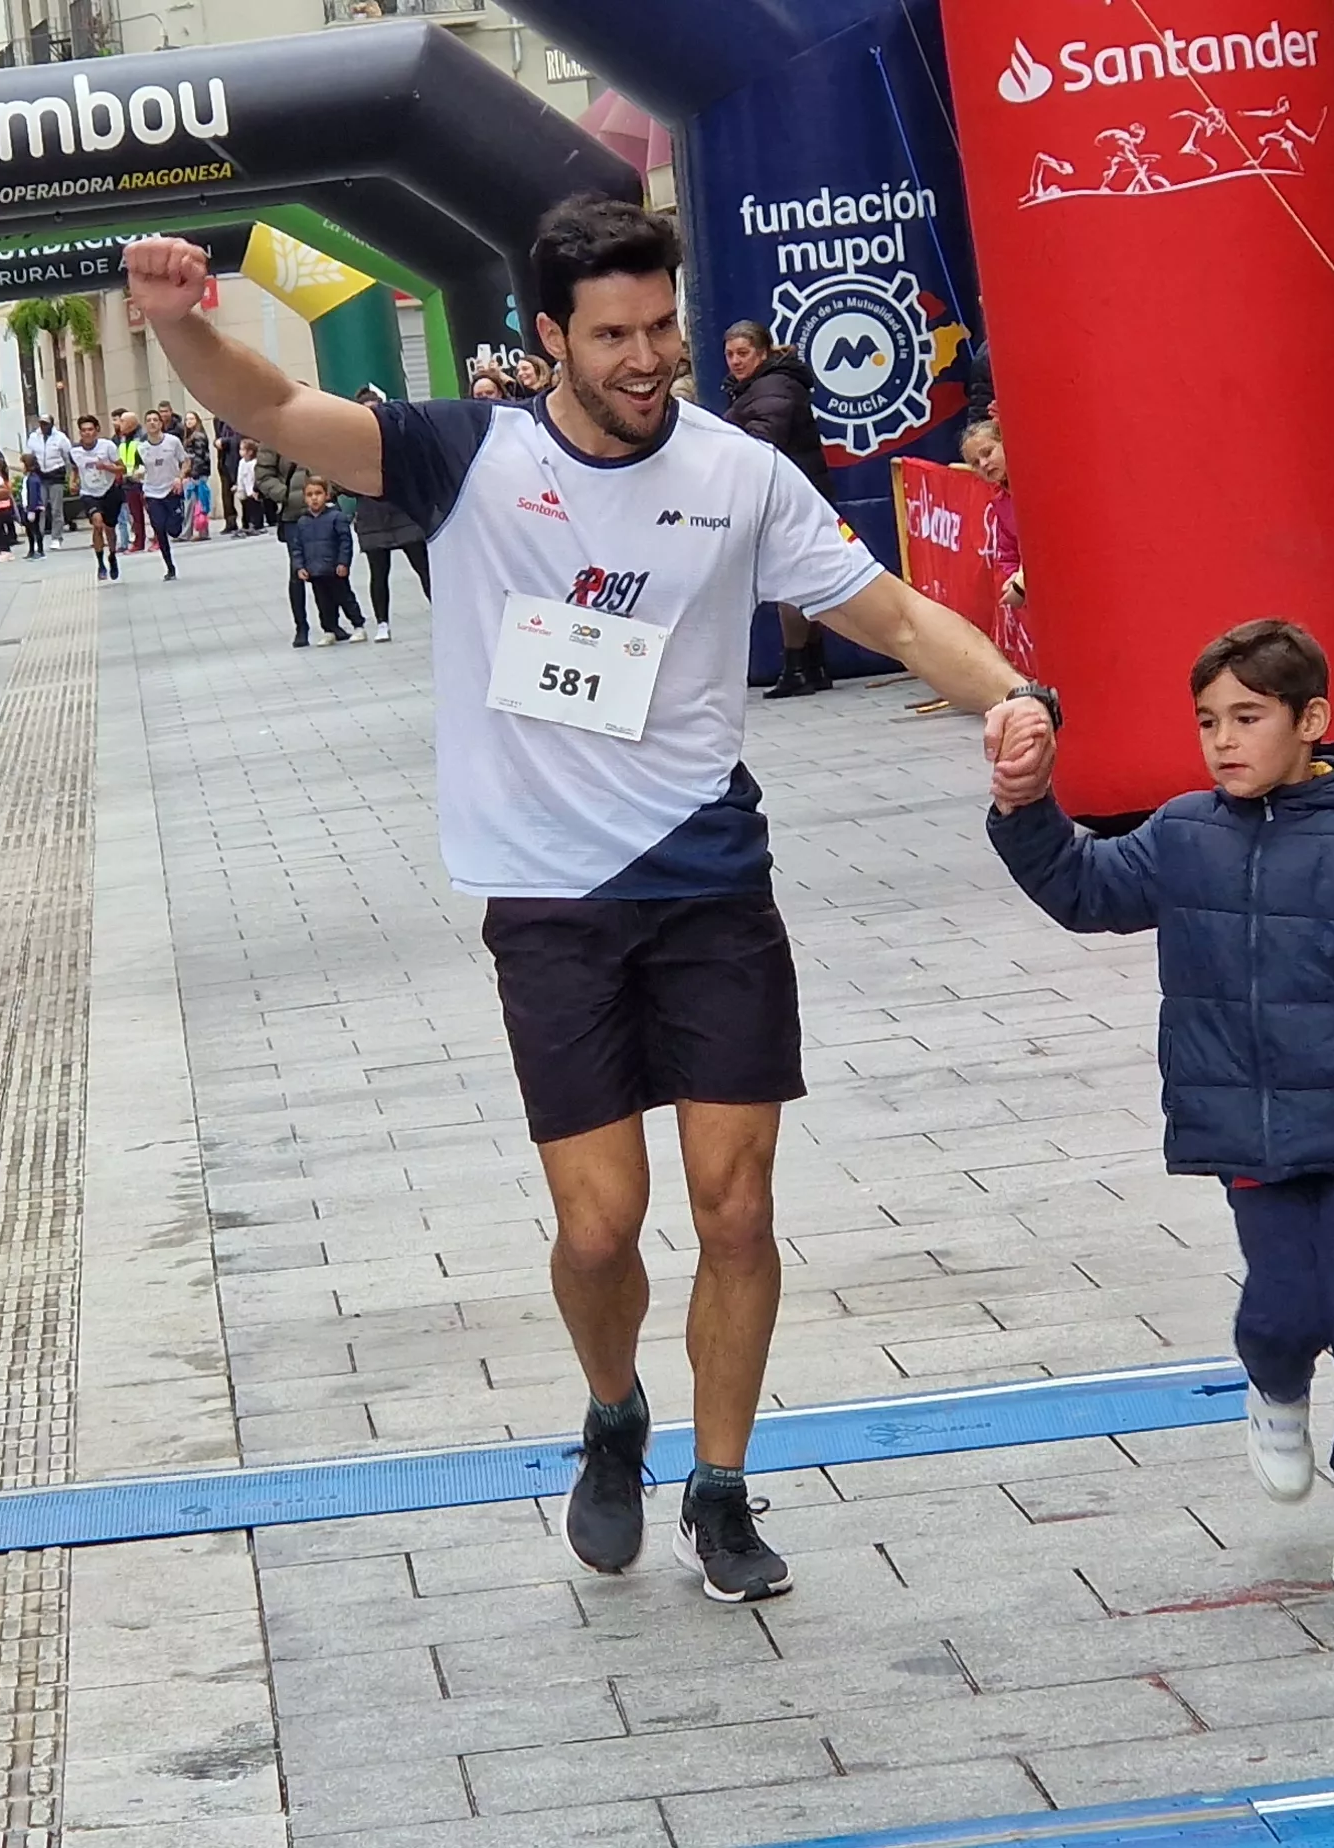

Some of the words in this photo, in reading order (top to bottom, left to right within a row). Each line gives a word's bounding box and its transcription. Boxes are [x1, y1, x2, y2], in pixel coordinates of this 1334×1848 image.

[1059, 20, 1319, 92] Santander
[0, 177, 115, 204] OPERADORA
[117, 163, 232, 190] ARAGONESA
[739, 179, 937, 236] fundación
[80, 258, 109, 274] DE
[777, 223, 906, 276] mupol
[796, 314, 819, 363] undación
[818, 306, 832, 317] de
[832, 300, 844, 309] la
[846, 296, 902, 331] Mutualidad
[826, 394, 889, 415] POLICÍA
[538, 662, 602, 703] 581
